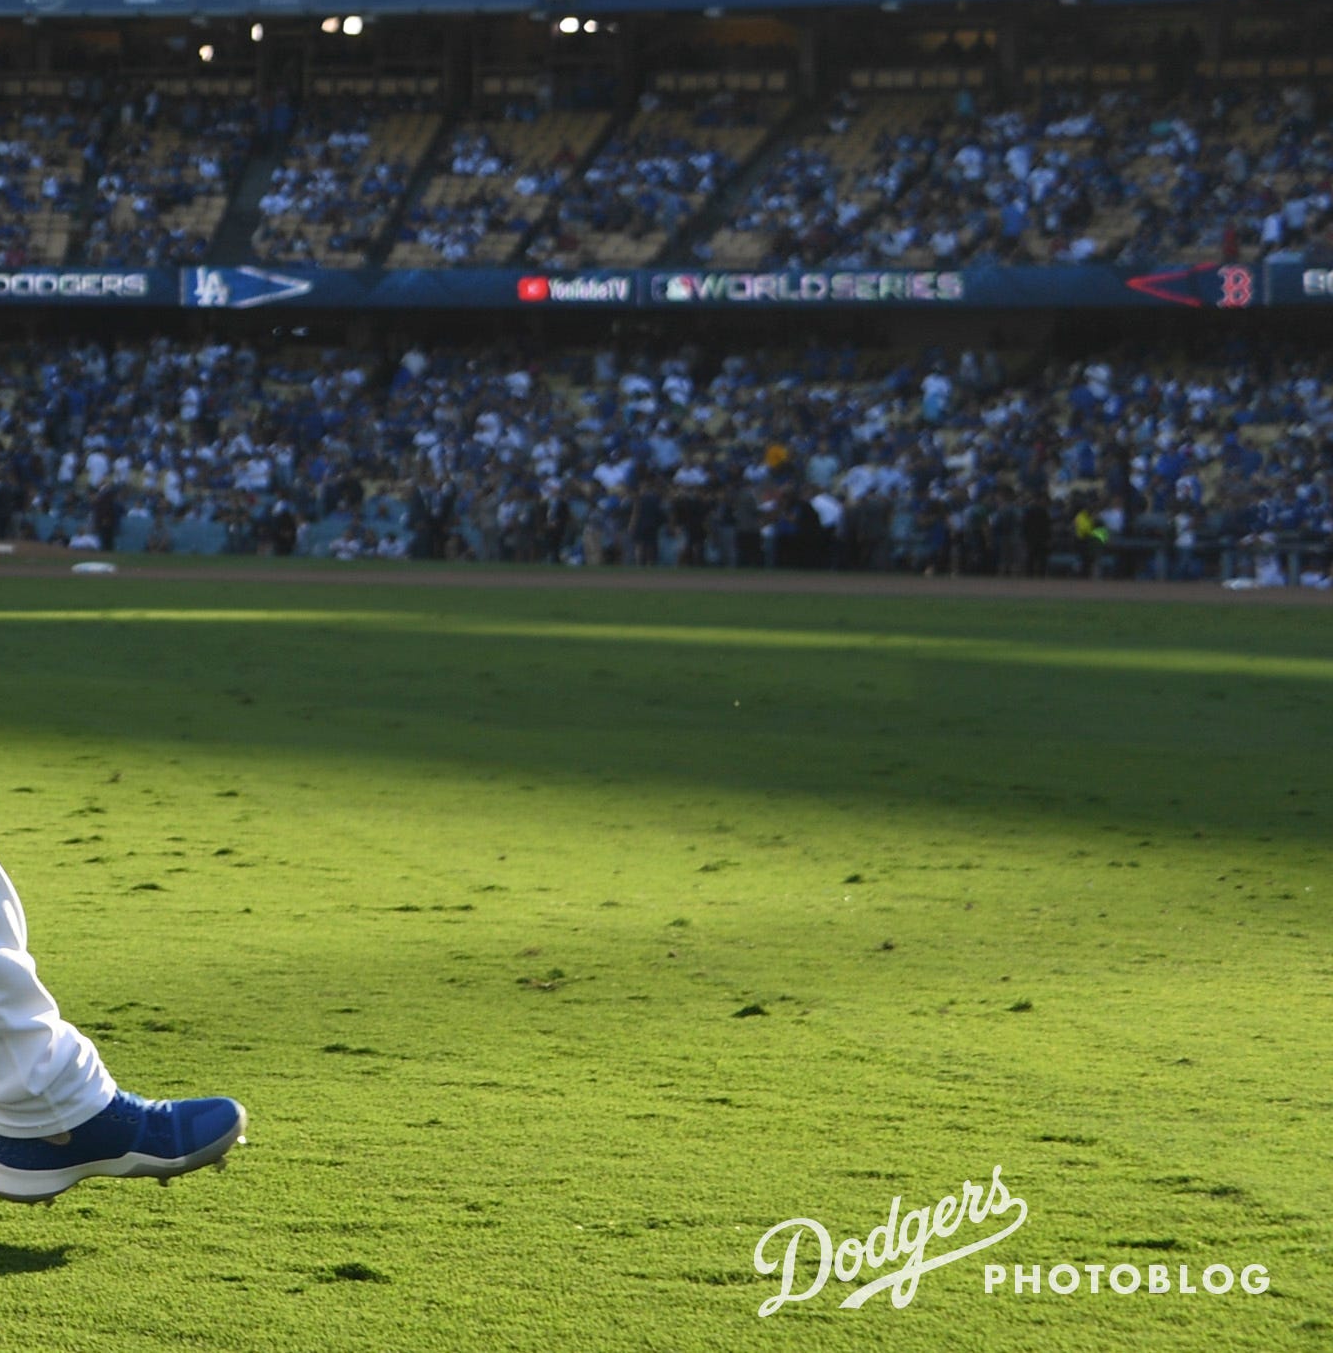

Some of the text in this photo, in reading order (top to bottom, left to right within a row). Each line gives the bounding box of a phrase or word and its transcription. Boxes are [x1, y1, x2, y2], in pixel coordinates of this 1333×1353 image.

[196, 264, 230, 306] LA
[694, 271, 965, 300] WORLD SERIES
[1217, 265, 1253, 308] B
